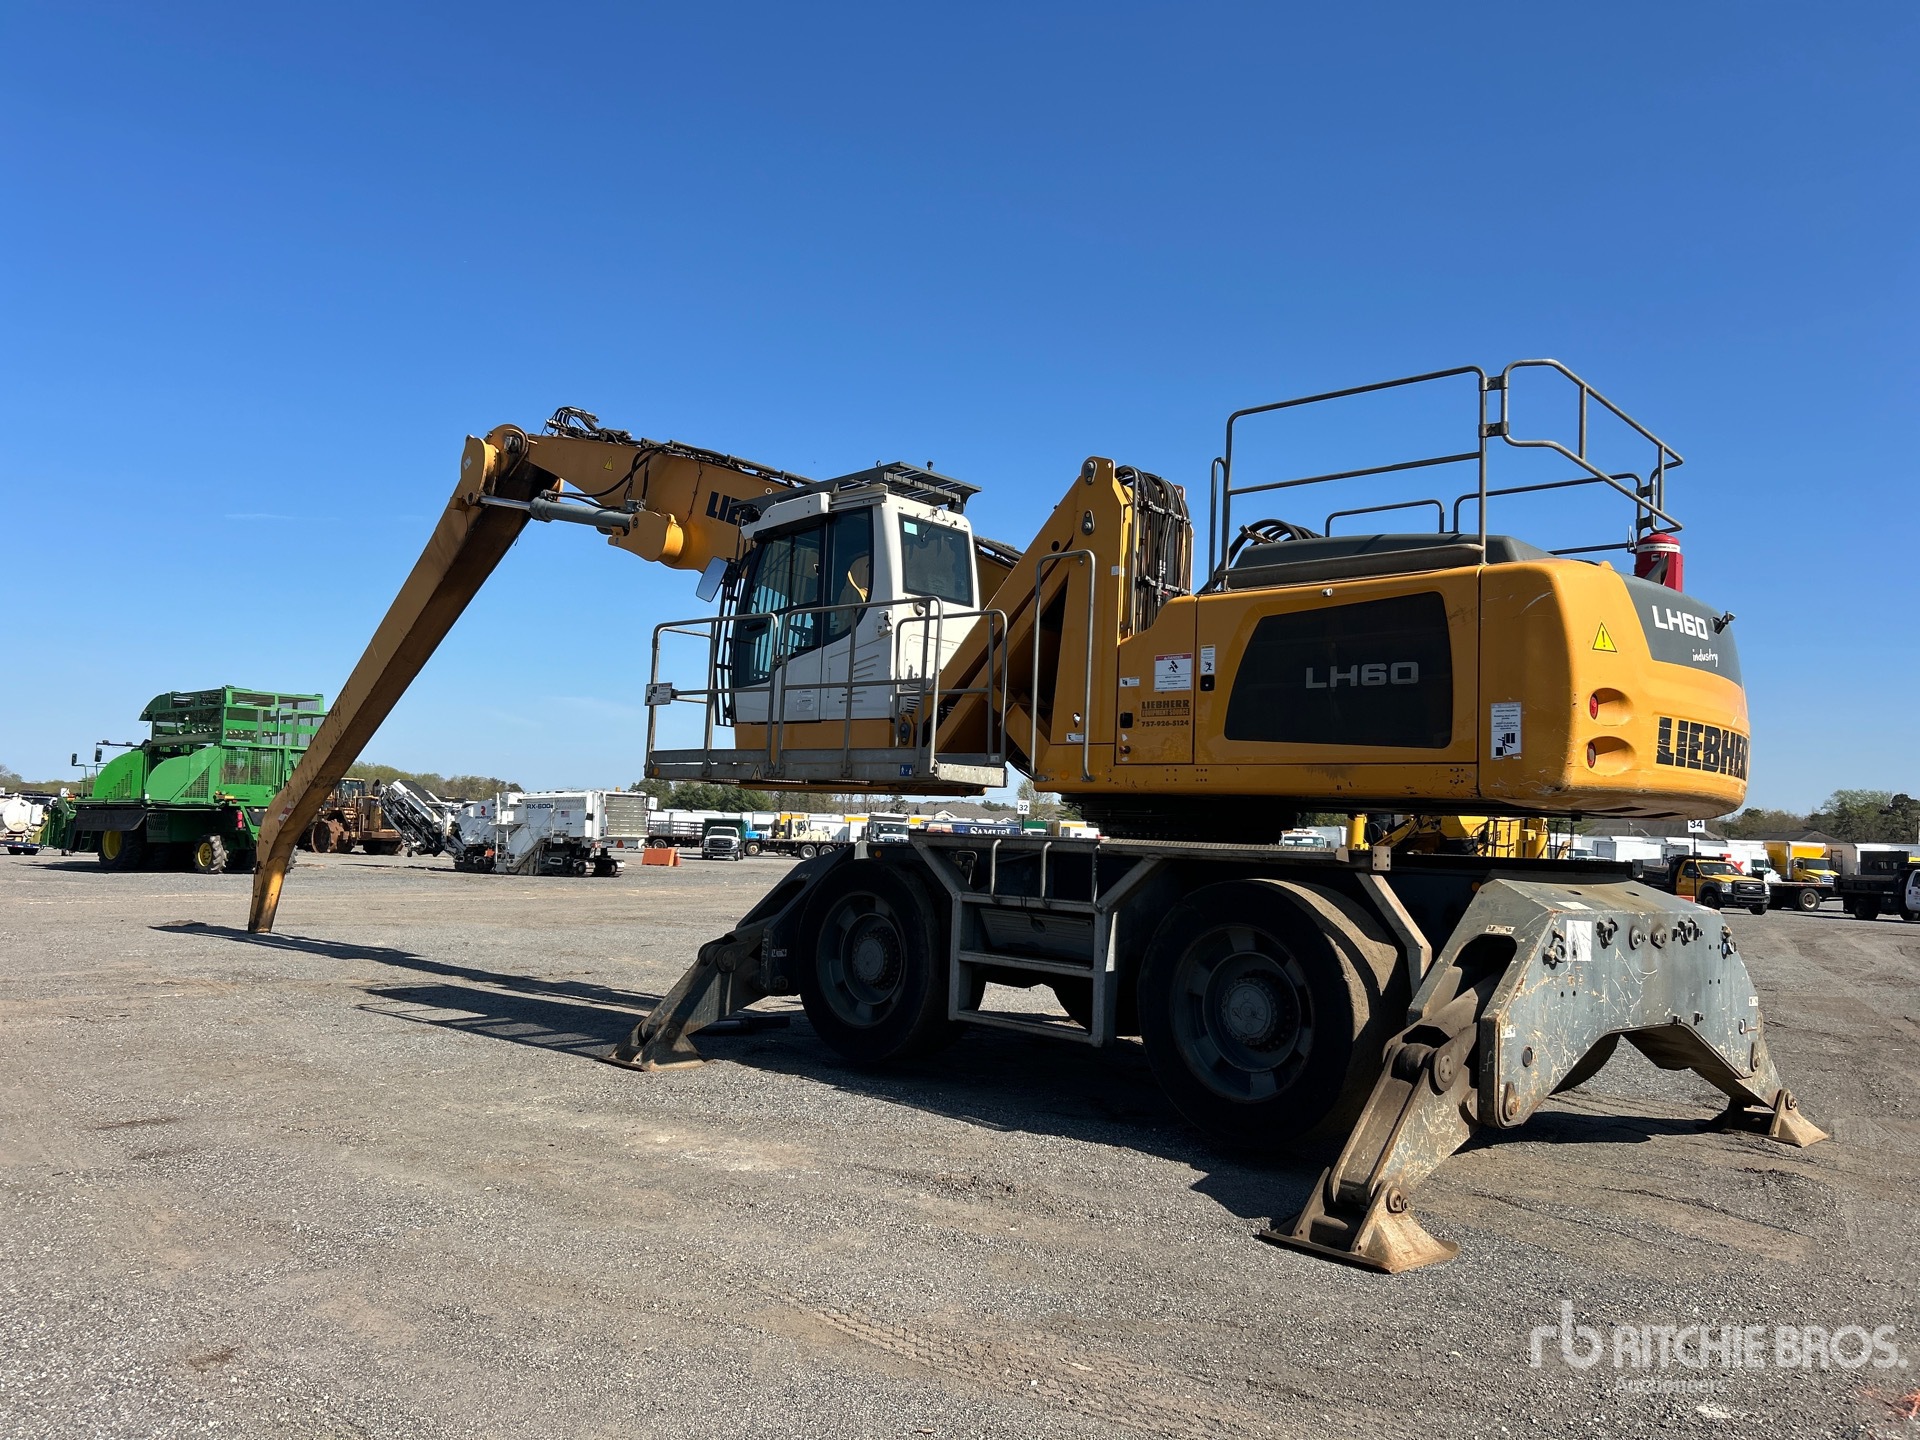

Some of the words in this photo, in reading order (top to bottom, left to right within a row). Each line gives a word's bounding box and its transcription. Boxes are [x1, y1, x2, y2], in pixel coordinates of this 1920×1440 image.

[1651, 605, 1709, 641] LH60
[1692, 648, 1719, 668] industry
[1305, 661, 1419, 689] LH60
[1141, 699, 1190, 709] LIEBHERR
[1169, 708, 1190, 716] SOURCE
[1018, 803, 1029, 812] 32
[1689, 819, 1703, 829] 34
